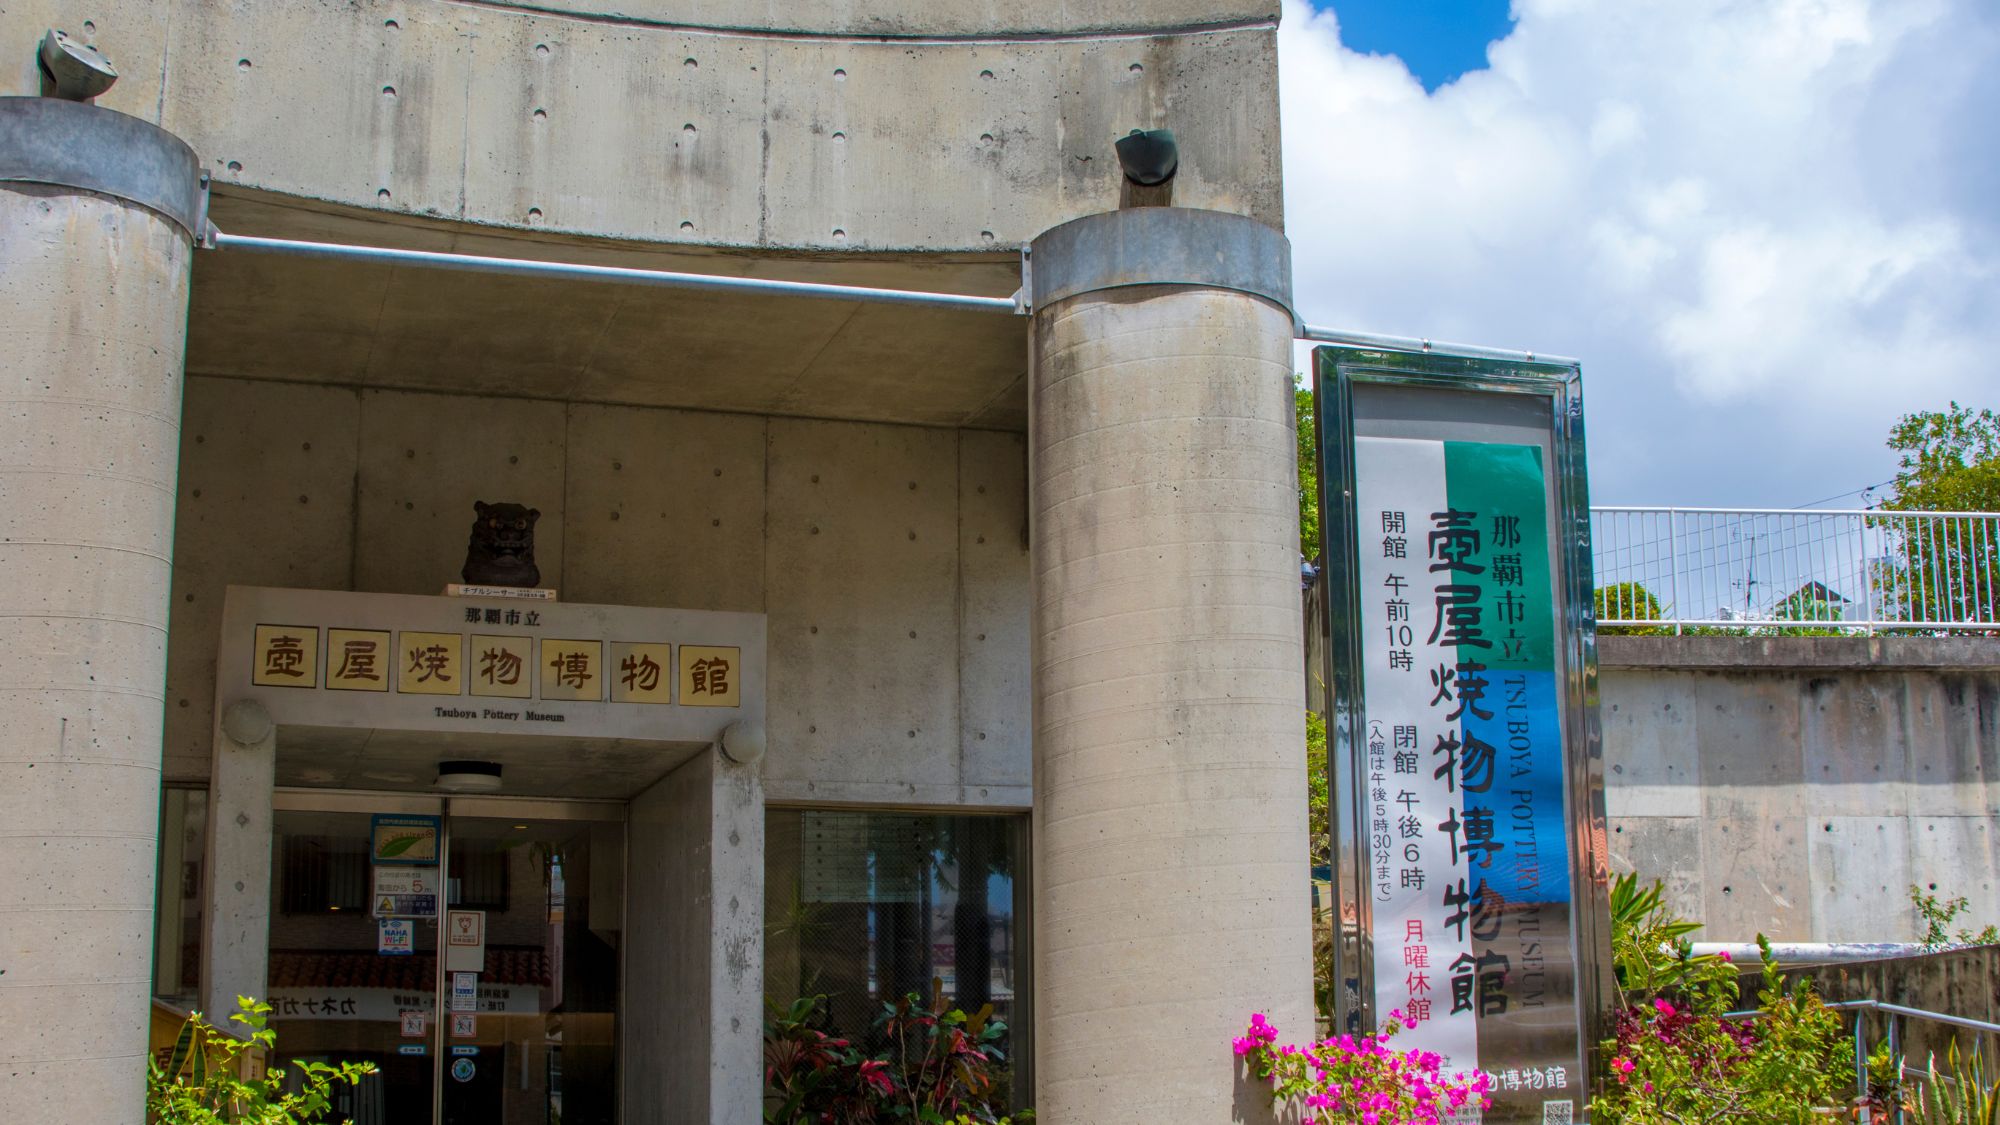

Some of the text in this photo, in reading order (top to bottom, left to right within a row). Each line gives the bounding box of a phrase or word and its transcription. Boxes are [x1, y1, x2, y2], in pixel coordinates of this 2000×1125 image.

[465, 607, 541, 626] 那覇市立
[1491, 514, 1528, 663] 那覇市立
[435, 707, 565, 722] Tsuboya Pottery Museum
[1381, 511, 1431, 1021] 開館 午前10時 閉館 午後6時 月曜休館
[1504, 675, 1545, 1008] TSUBOYA POTTERY MUSEUM
[412, 880, 423, 893] 5
